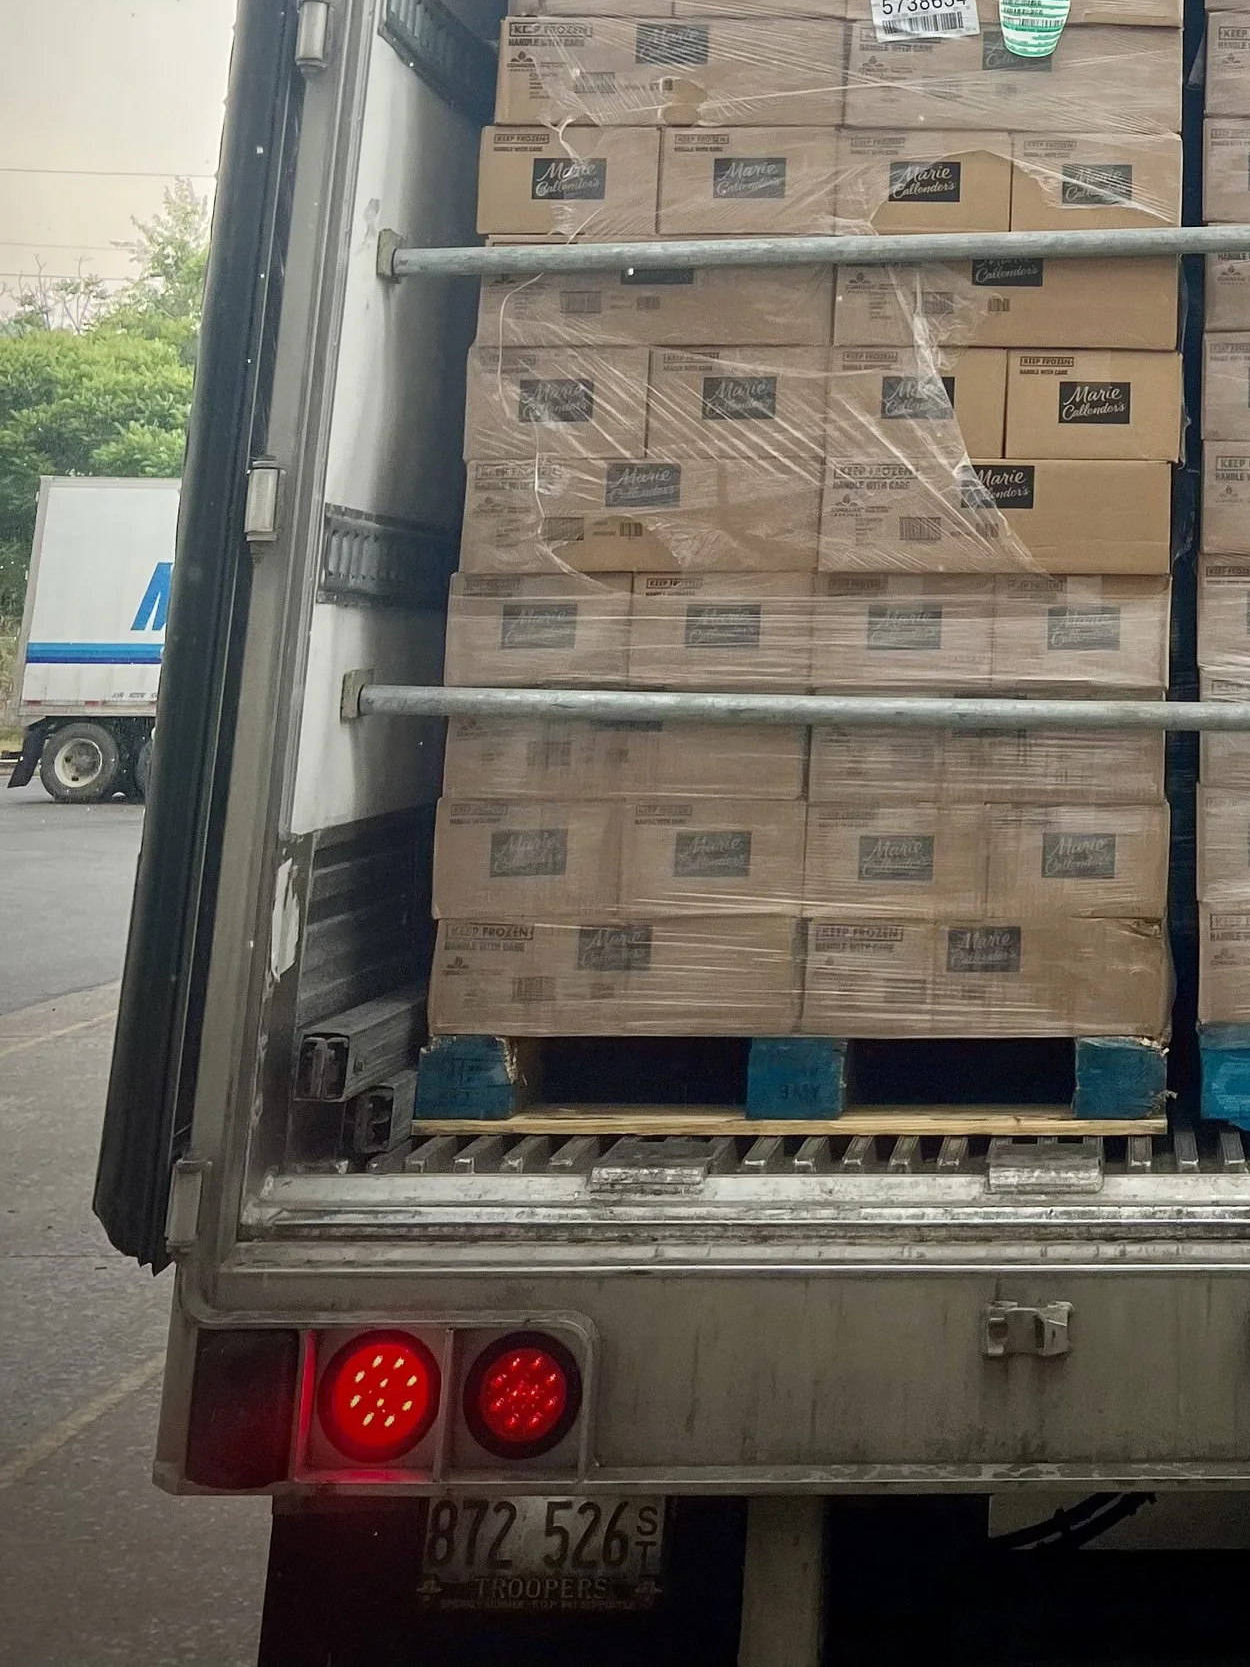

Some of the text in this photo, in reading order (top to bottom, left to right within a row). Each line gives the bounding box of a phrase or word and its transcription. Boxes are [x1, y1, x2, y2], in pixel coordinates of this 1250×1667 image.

[1223, 29, 1248, 38] KEEP
[721, 161, 777, 179] Marie
[895, 165, 952, 183] Marie
[1218, 253, 1246, 261] HANDLE
[975, 265, 1039, 283] Callender's
[1042, 358, 1073, 366] FROZEN
[711, 382, 765, 401] Marie
[1064, 387, 1122, 405] Marie
[1062, 402, 1126, 420] Callender's
[1220, 459, 1245, 468] KEEP
[482, 926, 529, 938] FROZEN
[428, 1499, 629, 1570] 872 526
[474, 1578, 607, 1599] TROOPERS
